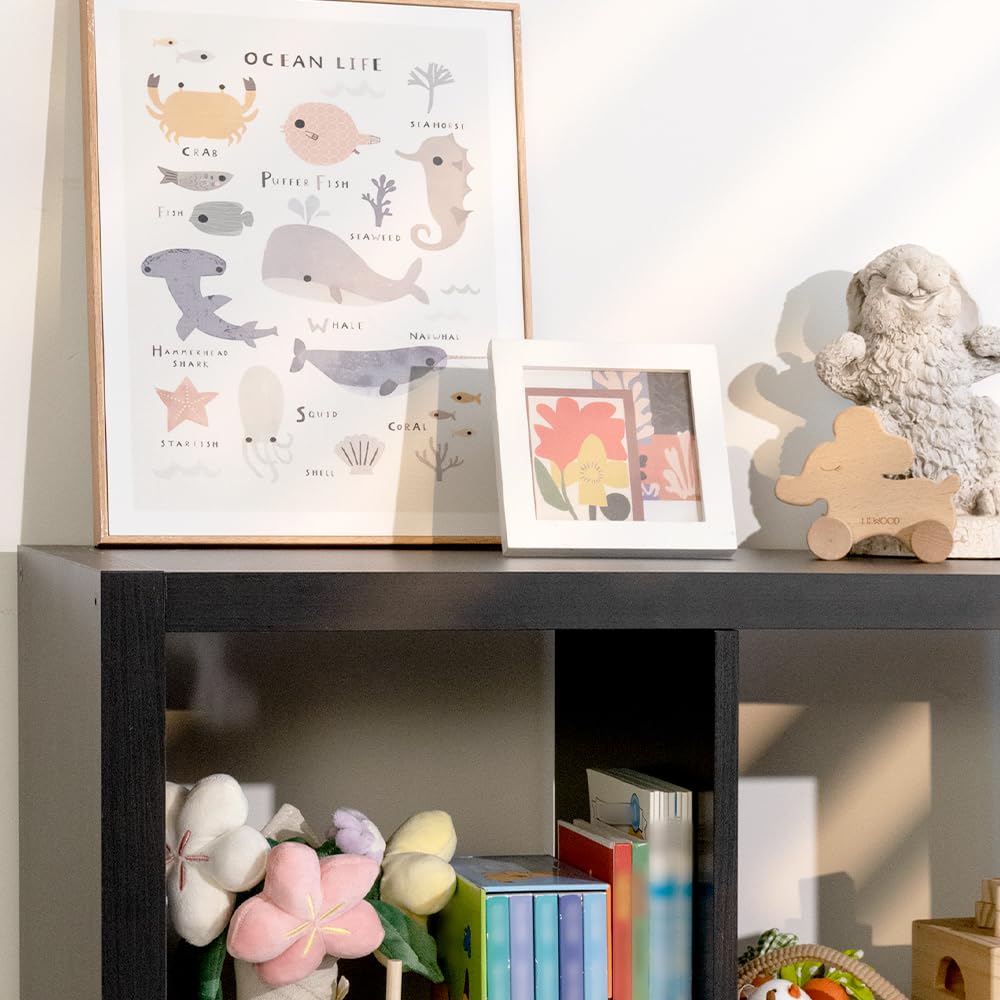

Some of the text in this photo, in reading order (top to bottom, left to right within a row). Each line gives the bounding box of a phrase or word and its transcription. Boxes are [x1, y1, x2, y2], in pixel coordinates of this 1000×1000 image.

[244, 51, 383, 72] OCEAN LIFE
[410, 121, 465, 131] SEAHORSE
[182, 147, 219, 158] CRAB
[261, 171, 350, 191] PUFFER FISH
[157, 206, 184, 218] FISH
[350, 233, 401, 242] SEAWEED
[308, 317, 365, 333] WHALE
[172, 360, 210, 369] SHARK
[296, 406, 338, 423] SQUID
[305, 469, 335, 477] SHELL
